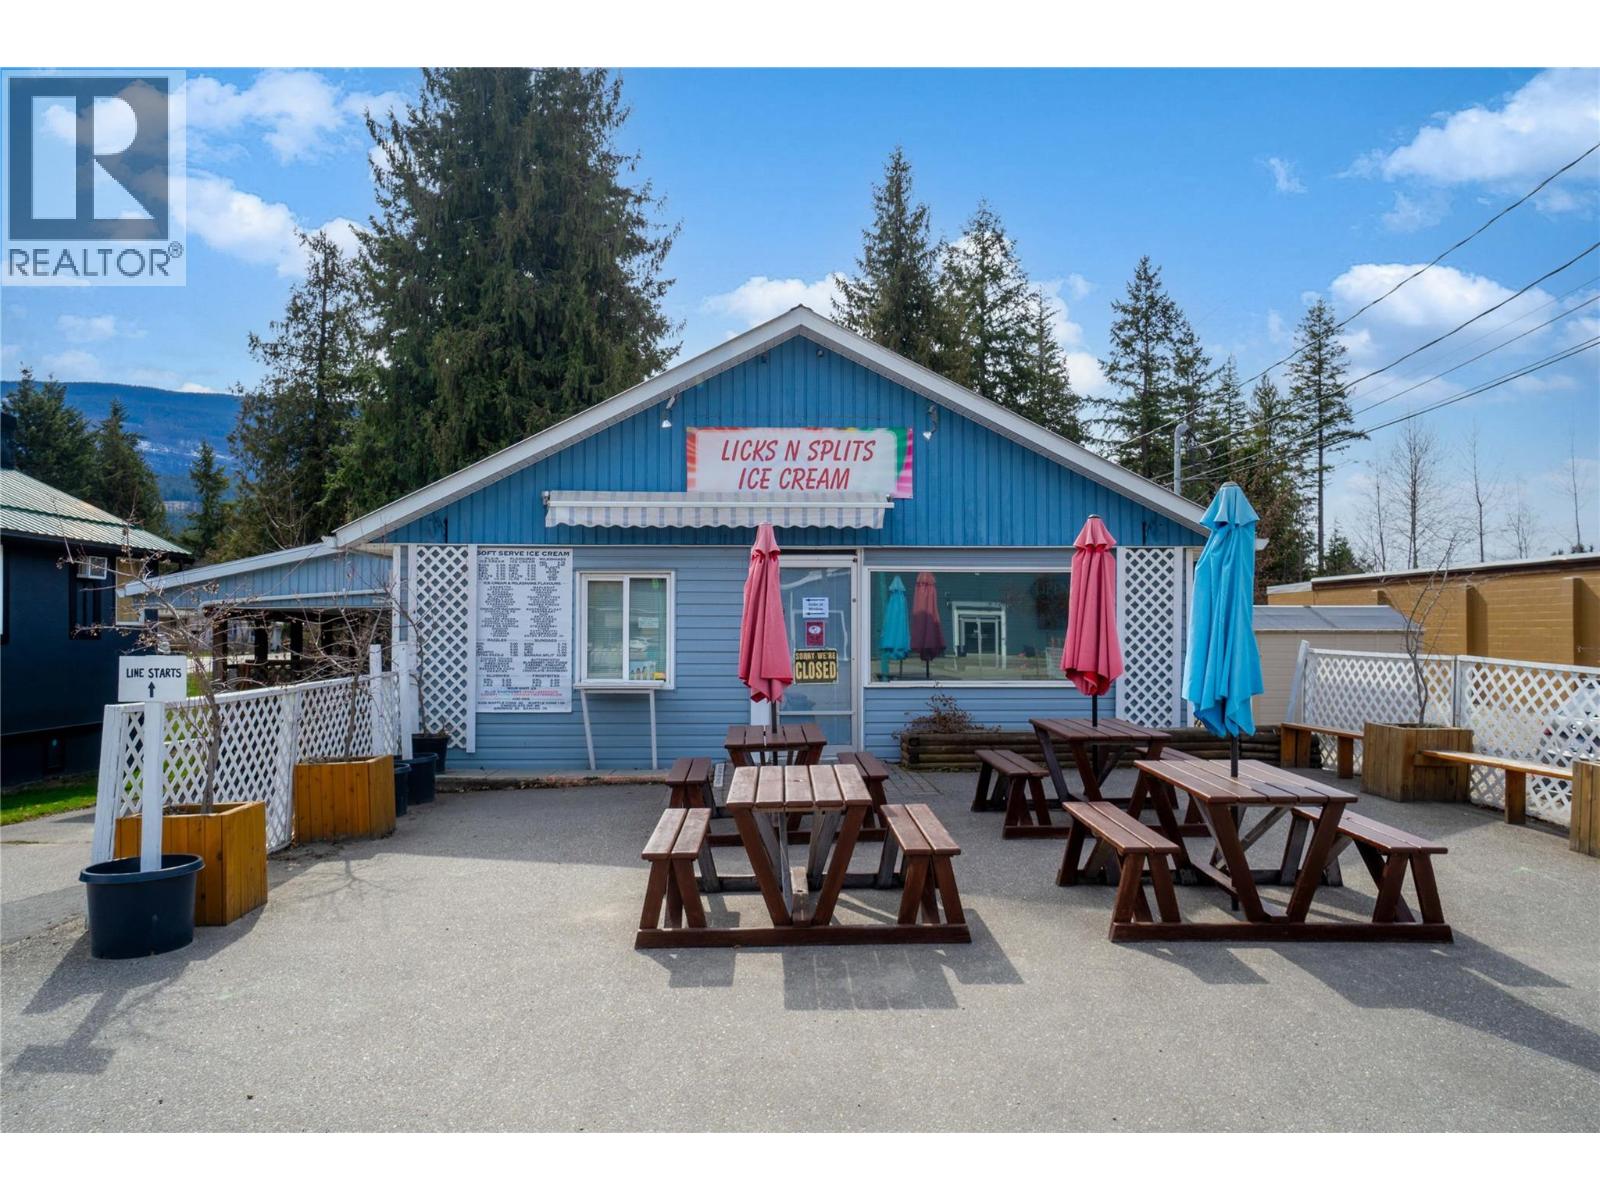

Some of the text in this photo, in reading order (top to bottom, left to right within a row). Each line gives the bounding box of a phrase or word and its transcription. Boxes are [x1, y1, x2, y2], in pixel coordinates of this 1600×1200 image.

[721, 439, 876, 462] LICKS N SPLITS
[738, 467, 851, 491] ICE CREAM
[126, 667, 182, 679] LINE STARTS
[795, 661, 837, 680] CLOSED
